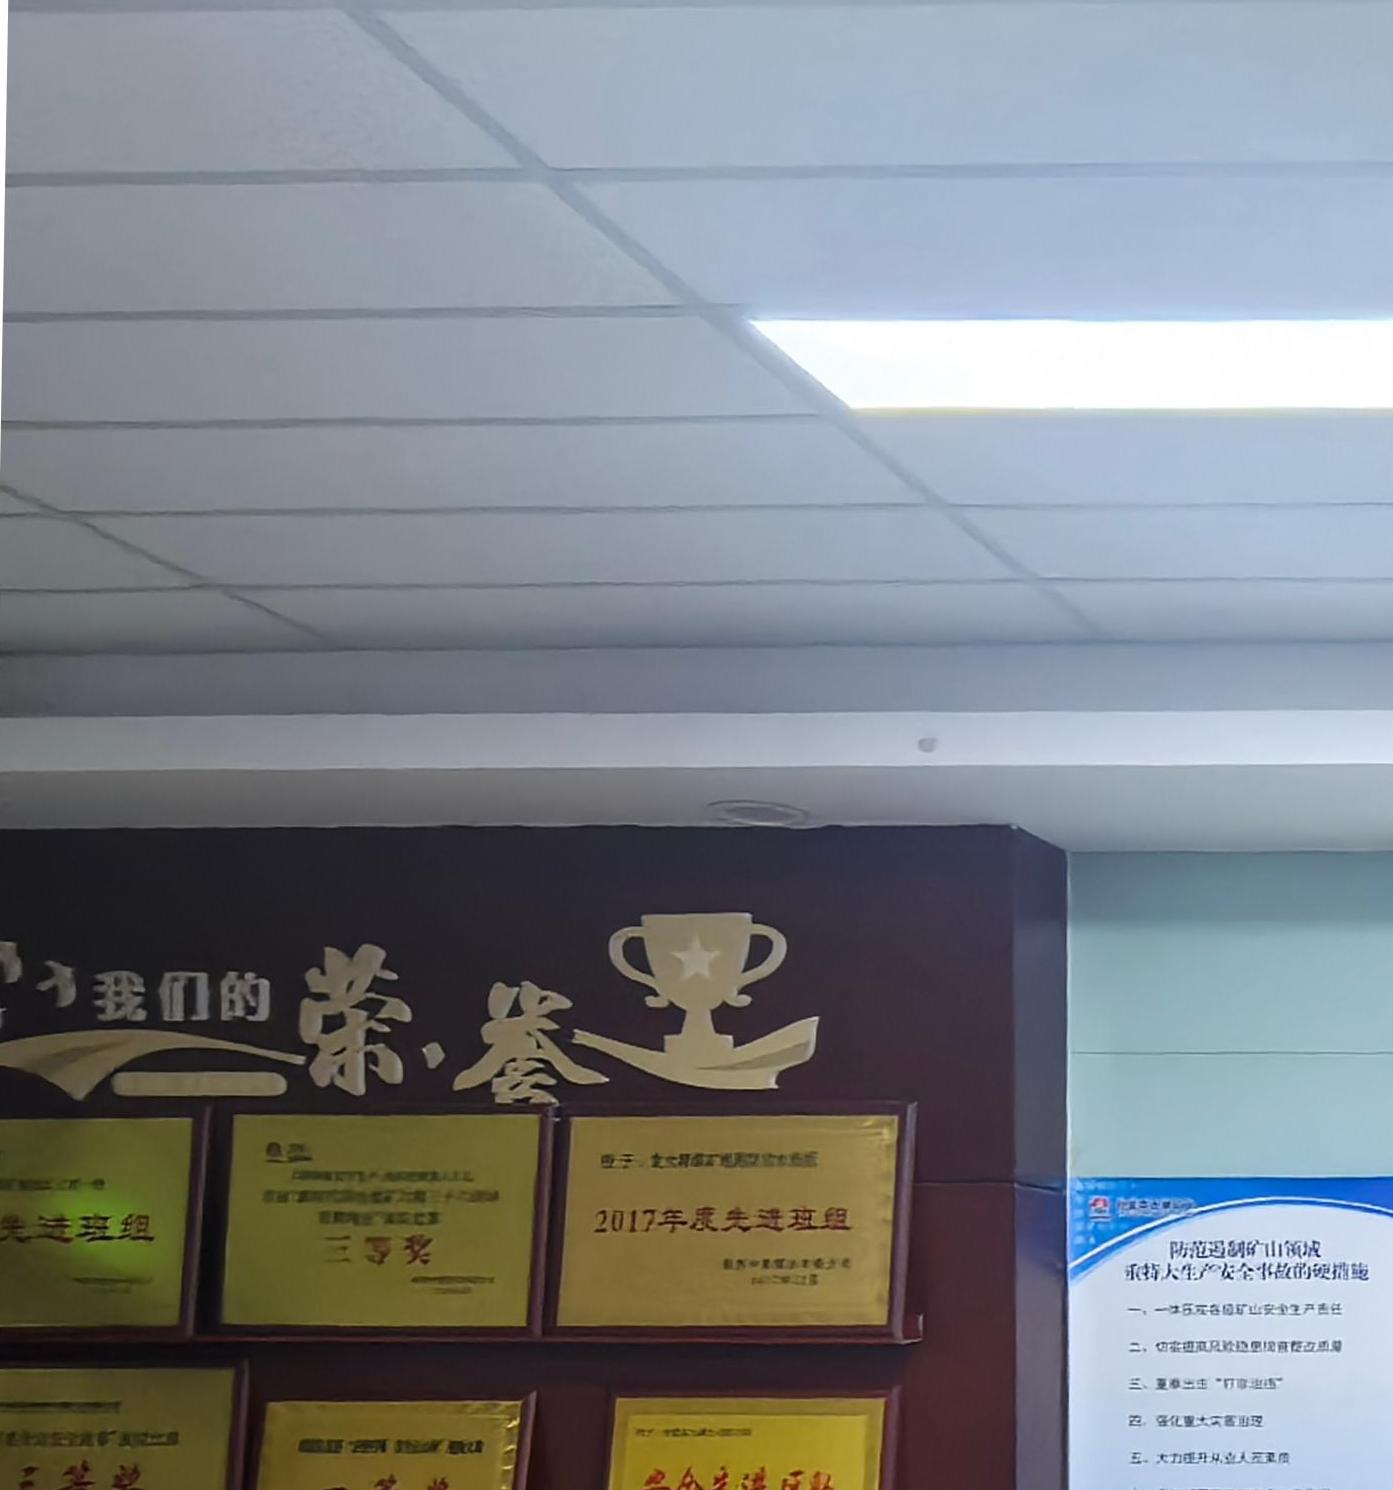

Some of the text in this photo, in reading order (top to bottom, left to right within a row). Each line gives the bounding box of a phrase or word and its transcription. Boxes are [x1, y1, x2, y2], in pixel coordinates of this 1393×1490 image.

[94, 970, 270, 1022] 我们的
[594, 1206, 851, 1234] 2017年度先进班组
